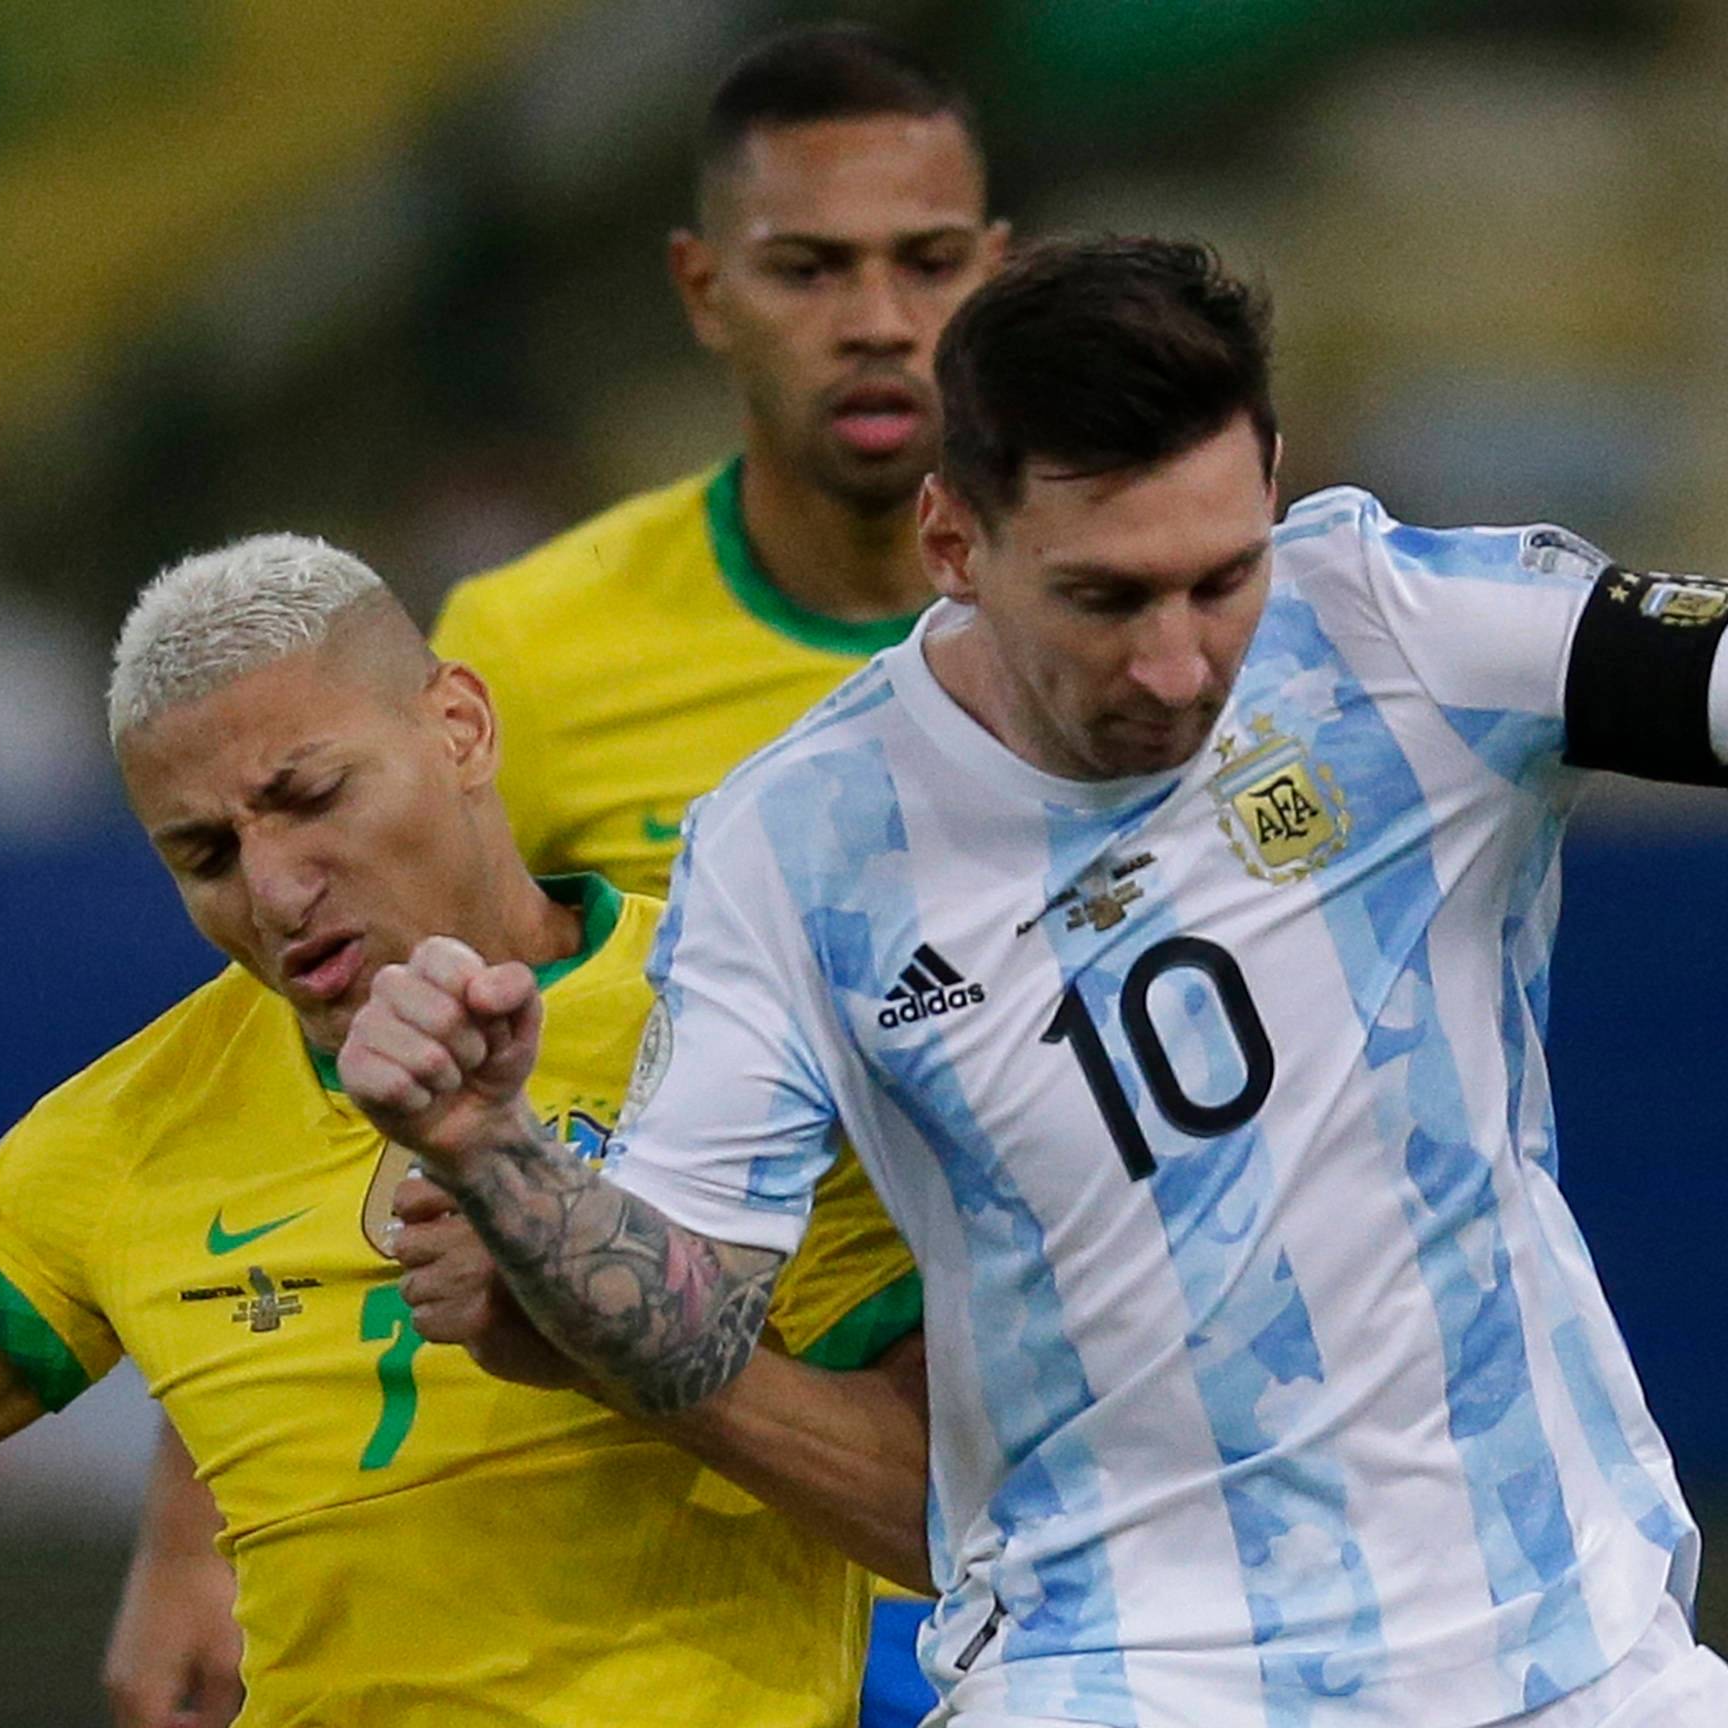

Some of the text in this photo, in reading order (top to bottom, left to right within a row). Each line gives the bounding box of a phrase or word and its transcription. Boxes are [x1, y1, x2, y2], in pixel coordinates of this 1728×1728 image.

[1248, 775, 1320, 844] AFA
[877, 980, 986, 1029] adidas
[1040, 934, 1274, 1182] 10
[360, 1282, 428, 1472] 7
